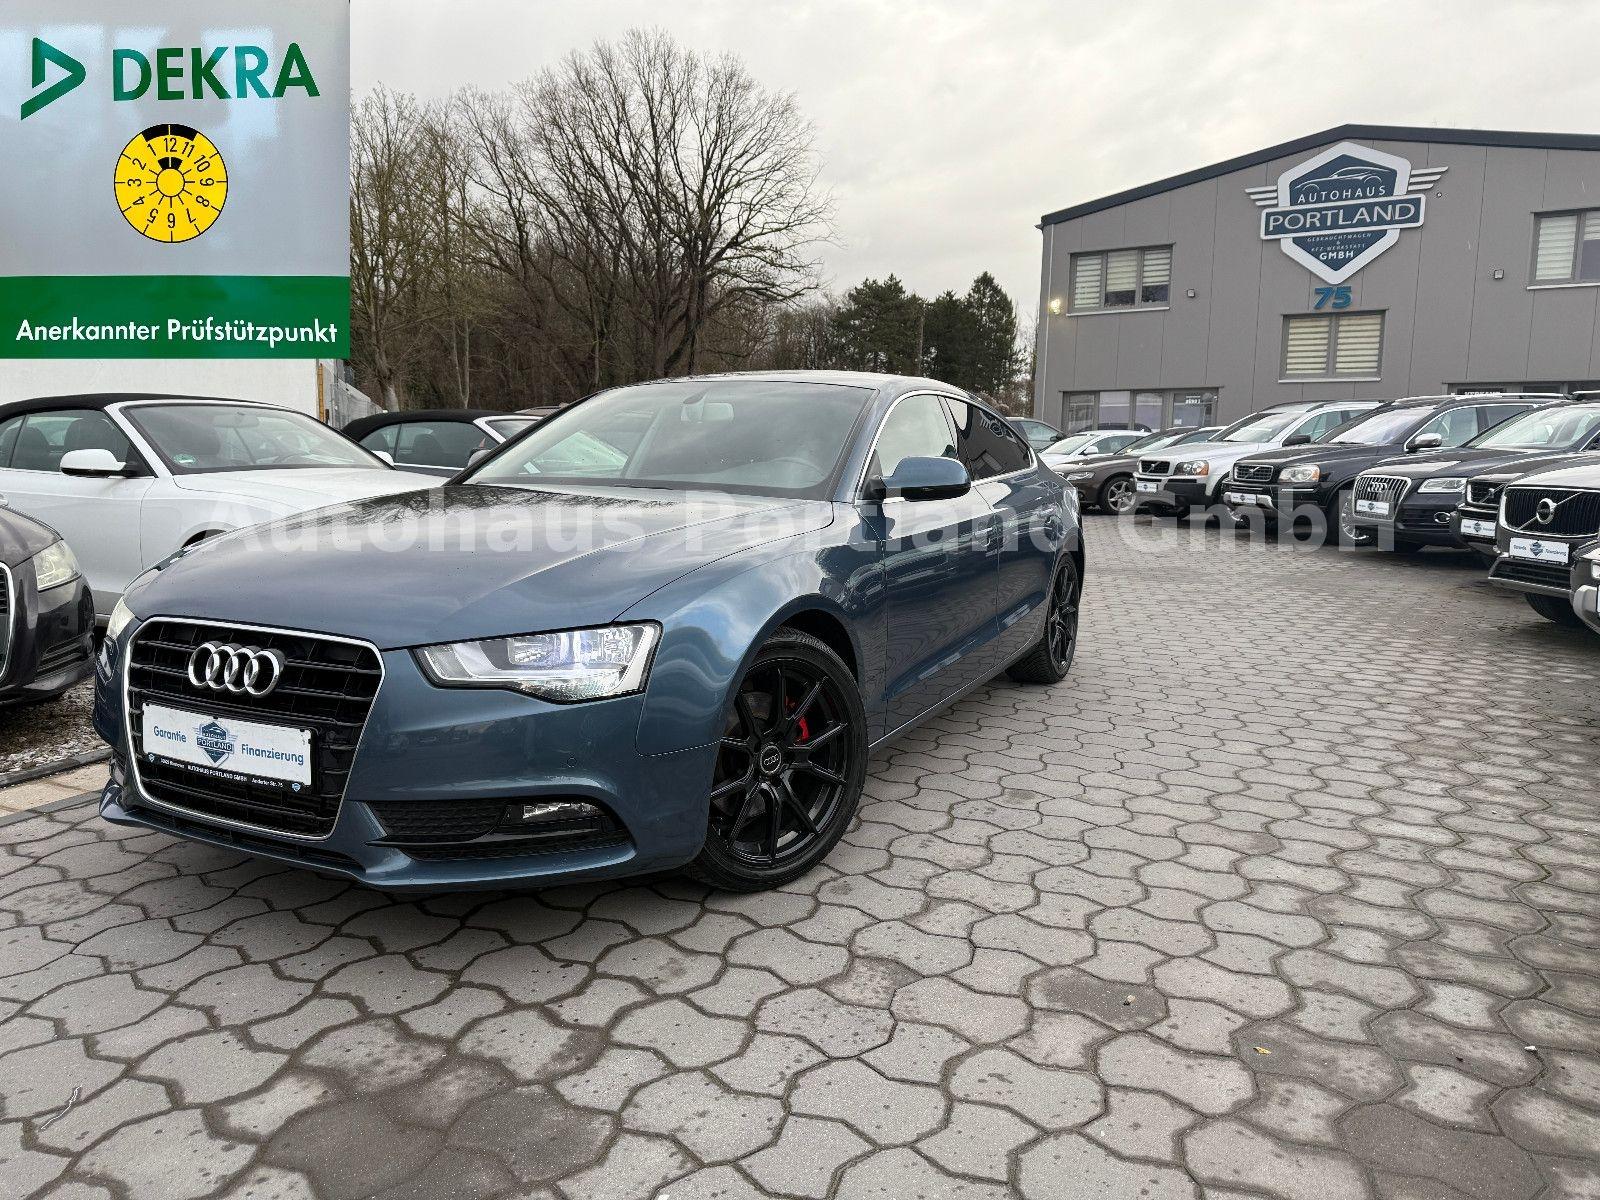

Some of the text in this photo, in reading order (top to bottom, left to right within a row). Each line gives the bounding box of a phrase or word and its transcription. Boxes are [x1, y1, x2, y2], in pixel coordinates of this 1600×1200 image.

[1297, 185, 1386, 203] AUTOHAUS
[1268, 203, 1415, 231] PORTLAND
[1320, 250, 1354, 260] GMBH
[1314, 286, 1353, 310] 75
[153, 726, 187, 743] Garantie
[241, 743, 304, 765] Finanzierung
